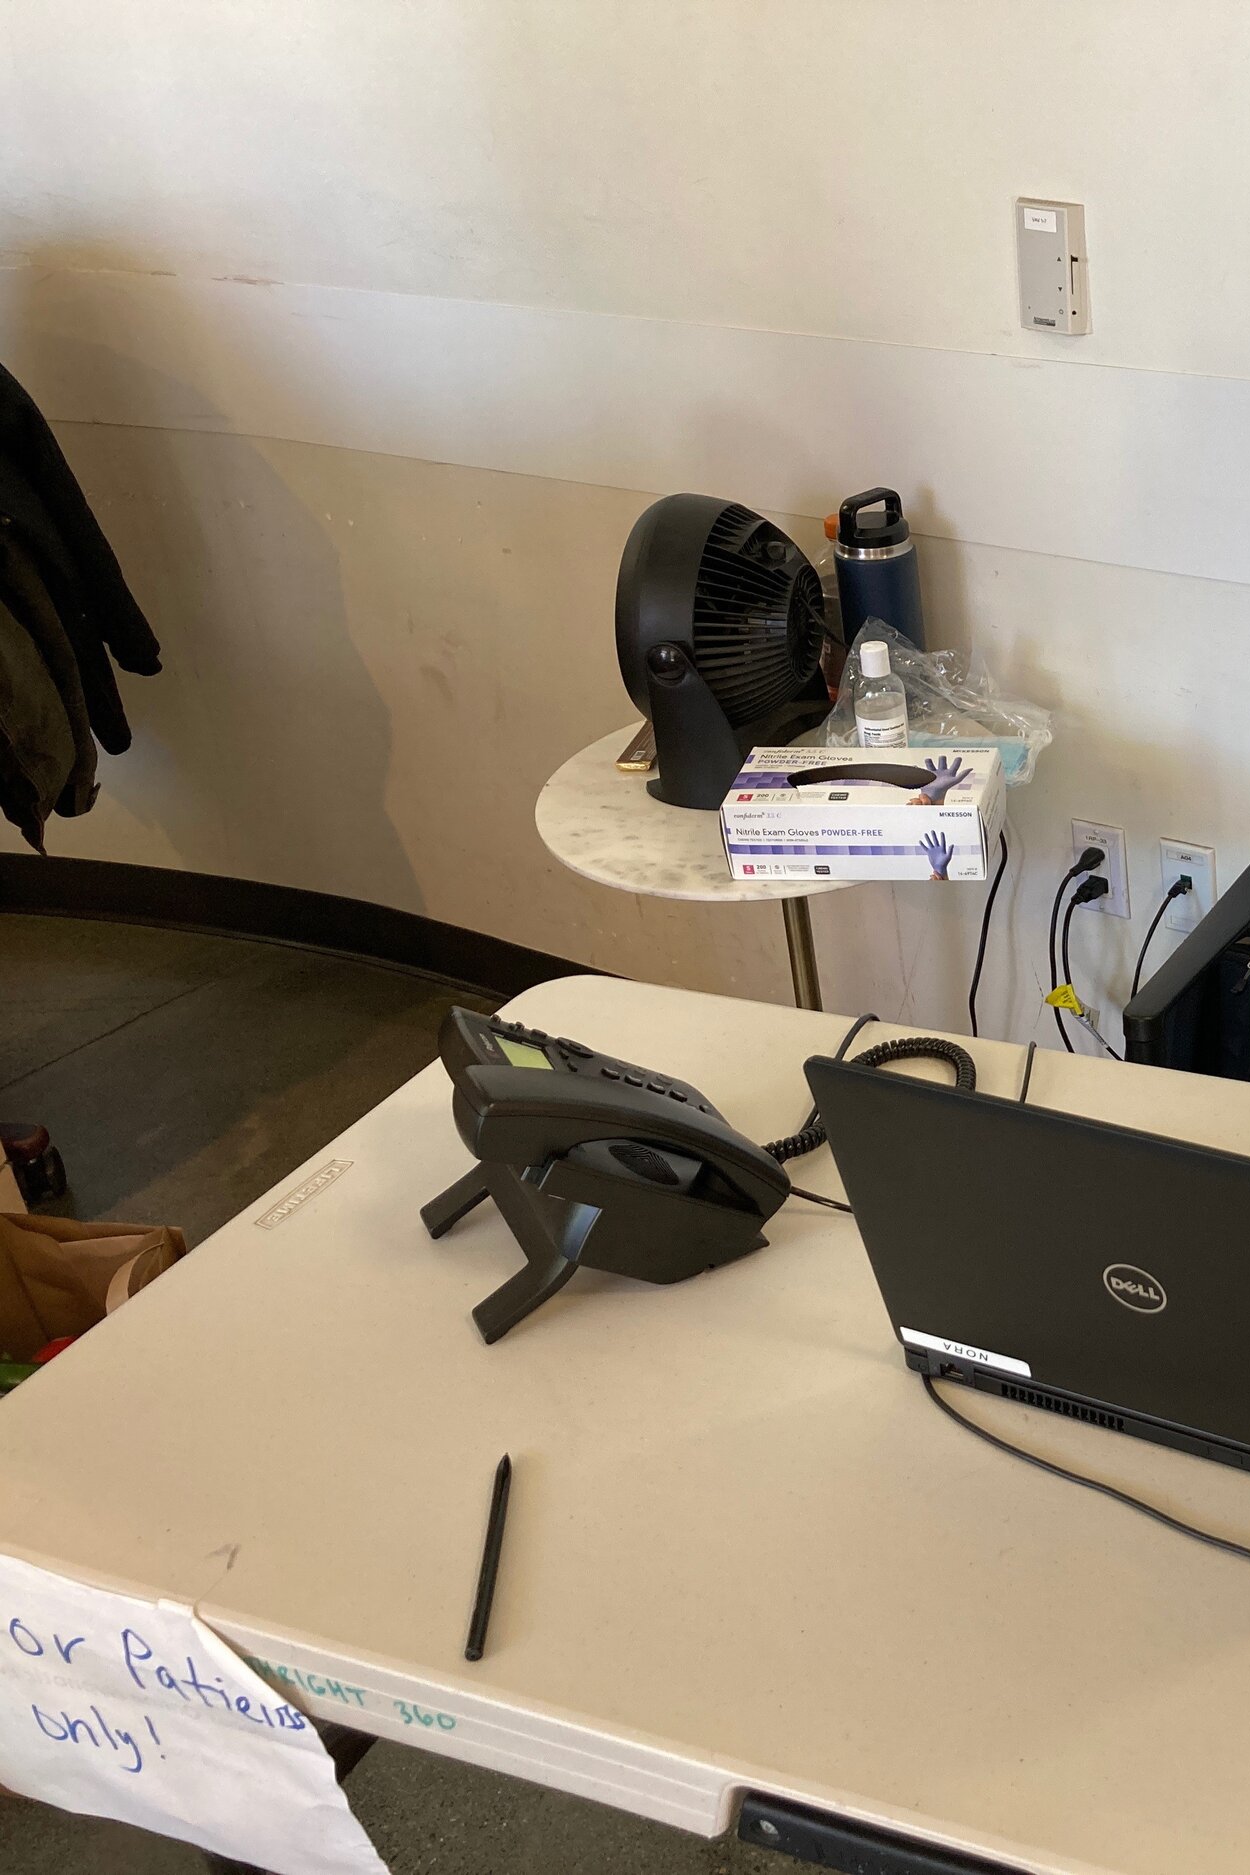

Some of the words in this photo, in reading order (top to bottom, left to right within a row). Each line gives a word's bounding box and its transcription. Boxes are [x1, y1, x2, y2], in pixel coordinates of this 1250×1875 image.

[736, 828, 761, 836] Nitrile
[762, 828, 786, 836] Exam
[788, 828, 820, 836] Gloves
[821, 829, 884, 837] POWDER-FREE
[1110, 1276, 1160, 1300] DELL
[943, 1342, 989, 1362] NORA
[393, 1701, 457, 1731] 360
